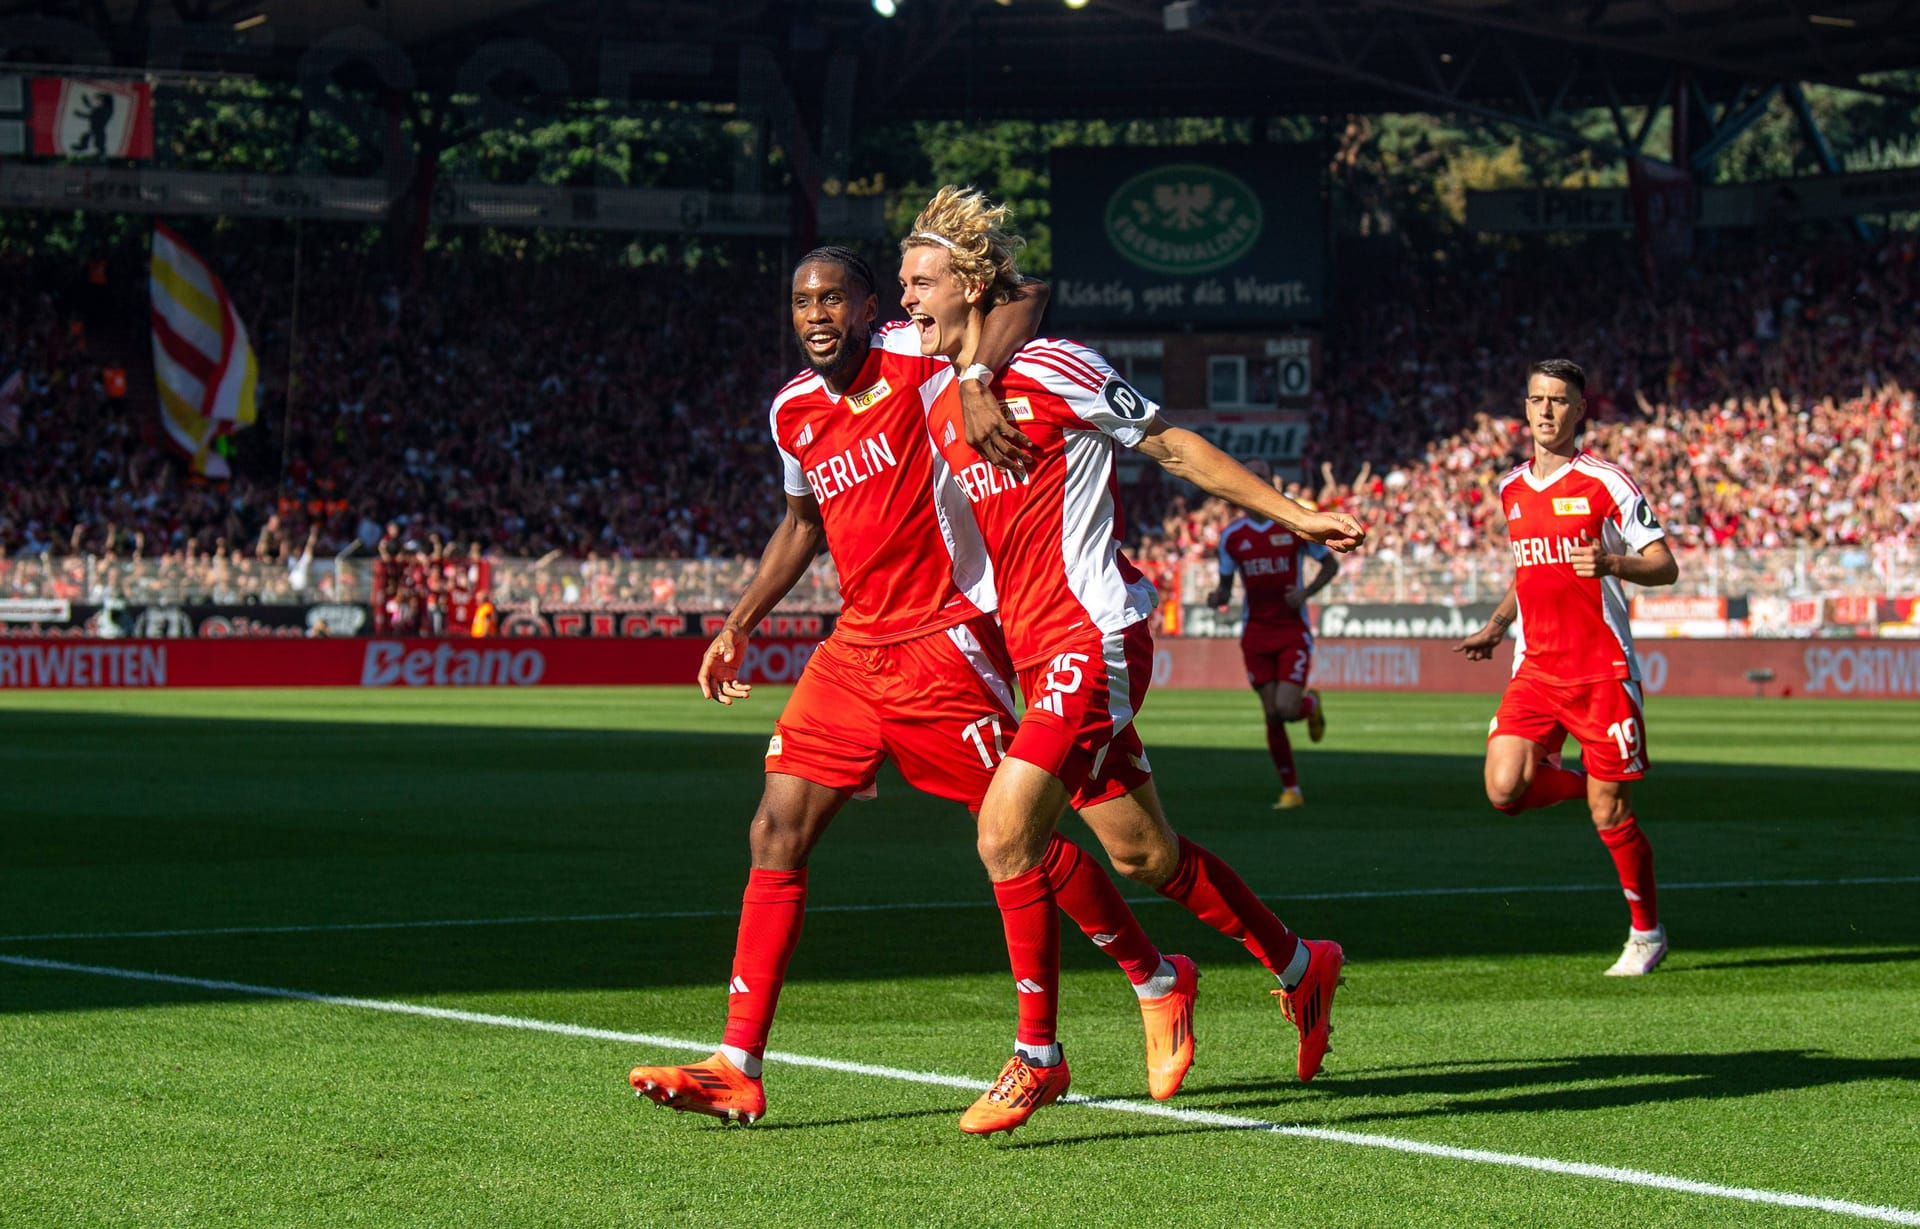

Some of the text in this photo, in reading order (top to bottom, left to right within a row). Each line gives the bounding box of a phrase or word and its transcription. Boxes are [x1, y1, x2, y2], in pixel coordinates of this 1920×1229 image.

[1112, 213, 1254, 262] EBERSWALDER
[1056, 279, 1135, 314] Richtig
[1192, 279, 1226, 306] die
[1233, 275, 1313, 309] Wurst.
[806, 432, 897, 505] BERLIN
[1242, 556, 1290, 576] BERLIN
[1512, 535, 1579, 568] BERLIN
[0, 645, 168, 687] RTWETTEN
[360, 640, 547, 687] Betano
[737, 643, 818, 681] POR
[1044, 652, 1089, 694] 15
[1293, 649, 1307, 673] 2
[961, 713, 1007, 769] 17
[1607, 717, 1641, 760] 19
